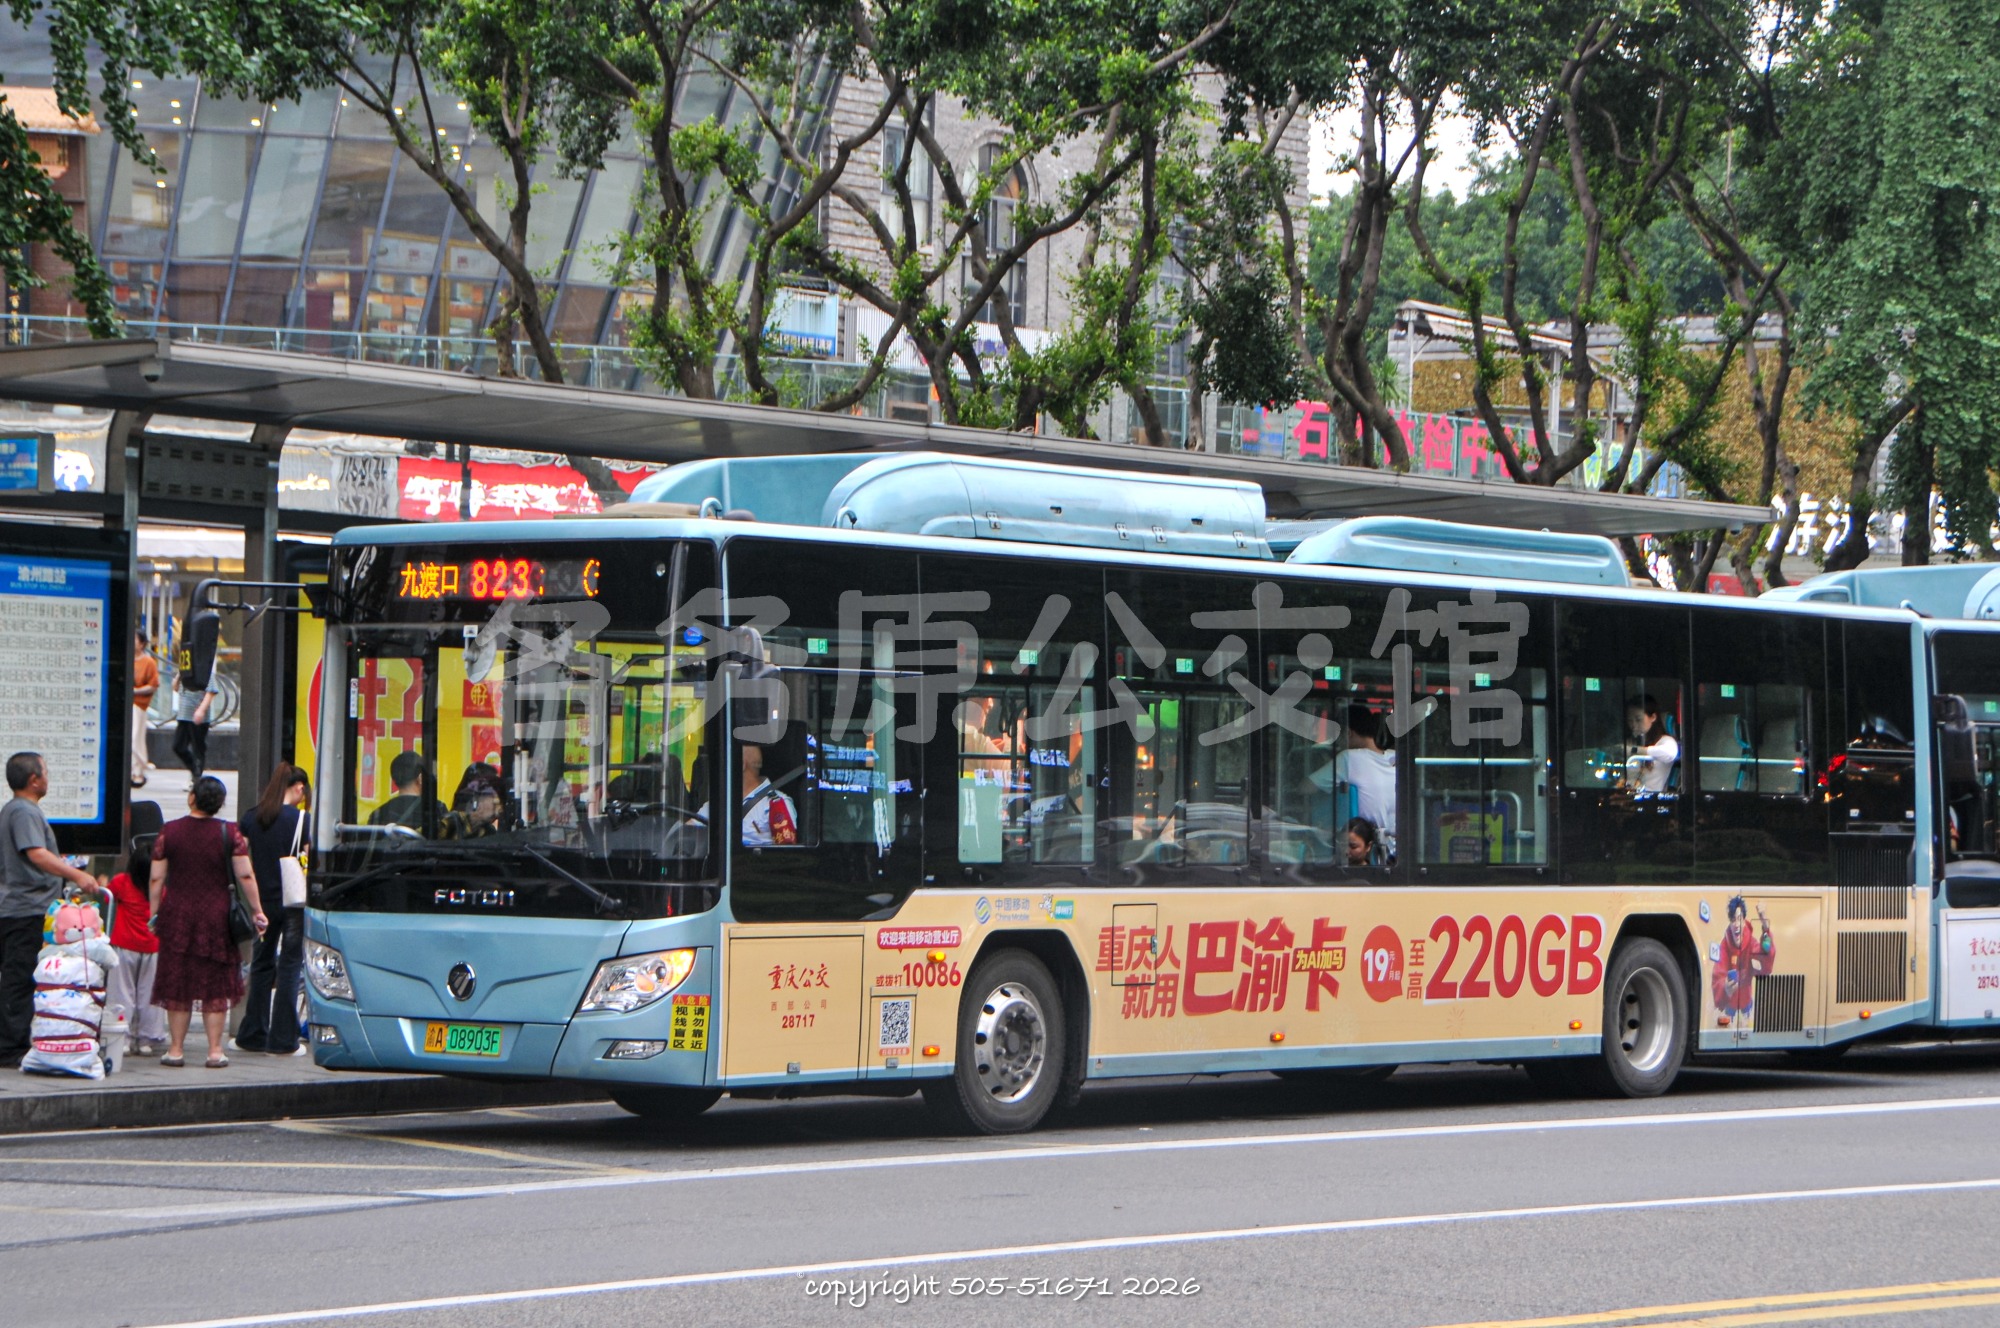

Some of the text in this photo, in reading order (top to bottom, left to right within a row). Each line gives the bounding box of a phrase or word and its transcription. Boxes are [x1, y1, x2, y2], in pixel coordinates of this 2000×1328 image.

[400, 561, 459, 598] 九渡口
[471, 559, 530, 598] 823
[1096, 924, 1181, 971] 重庆人
[1182, 916, 1348, 1017] 巴渝卡
[1363, 948, 1389, 982] 19
[1423, 914, 1606, 1003] 220GB
[768, 963, 830, 990] 重庆公交
[1120, 973, 1180, 1020] 就用
[782, 1014, 815, 1029] 28717
